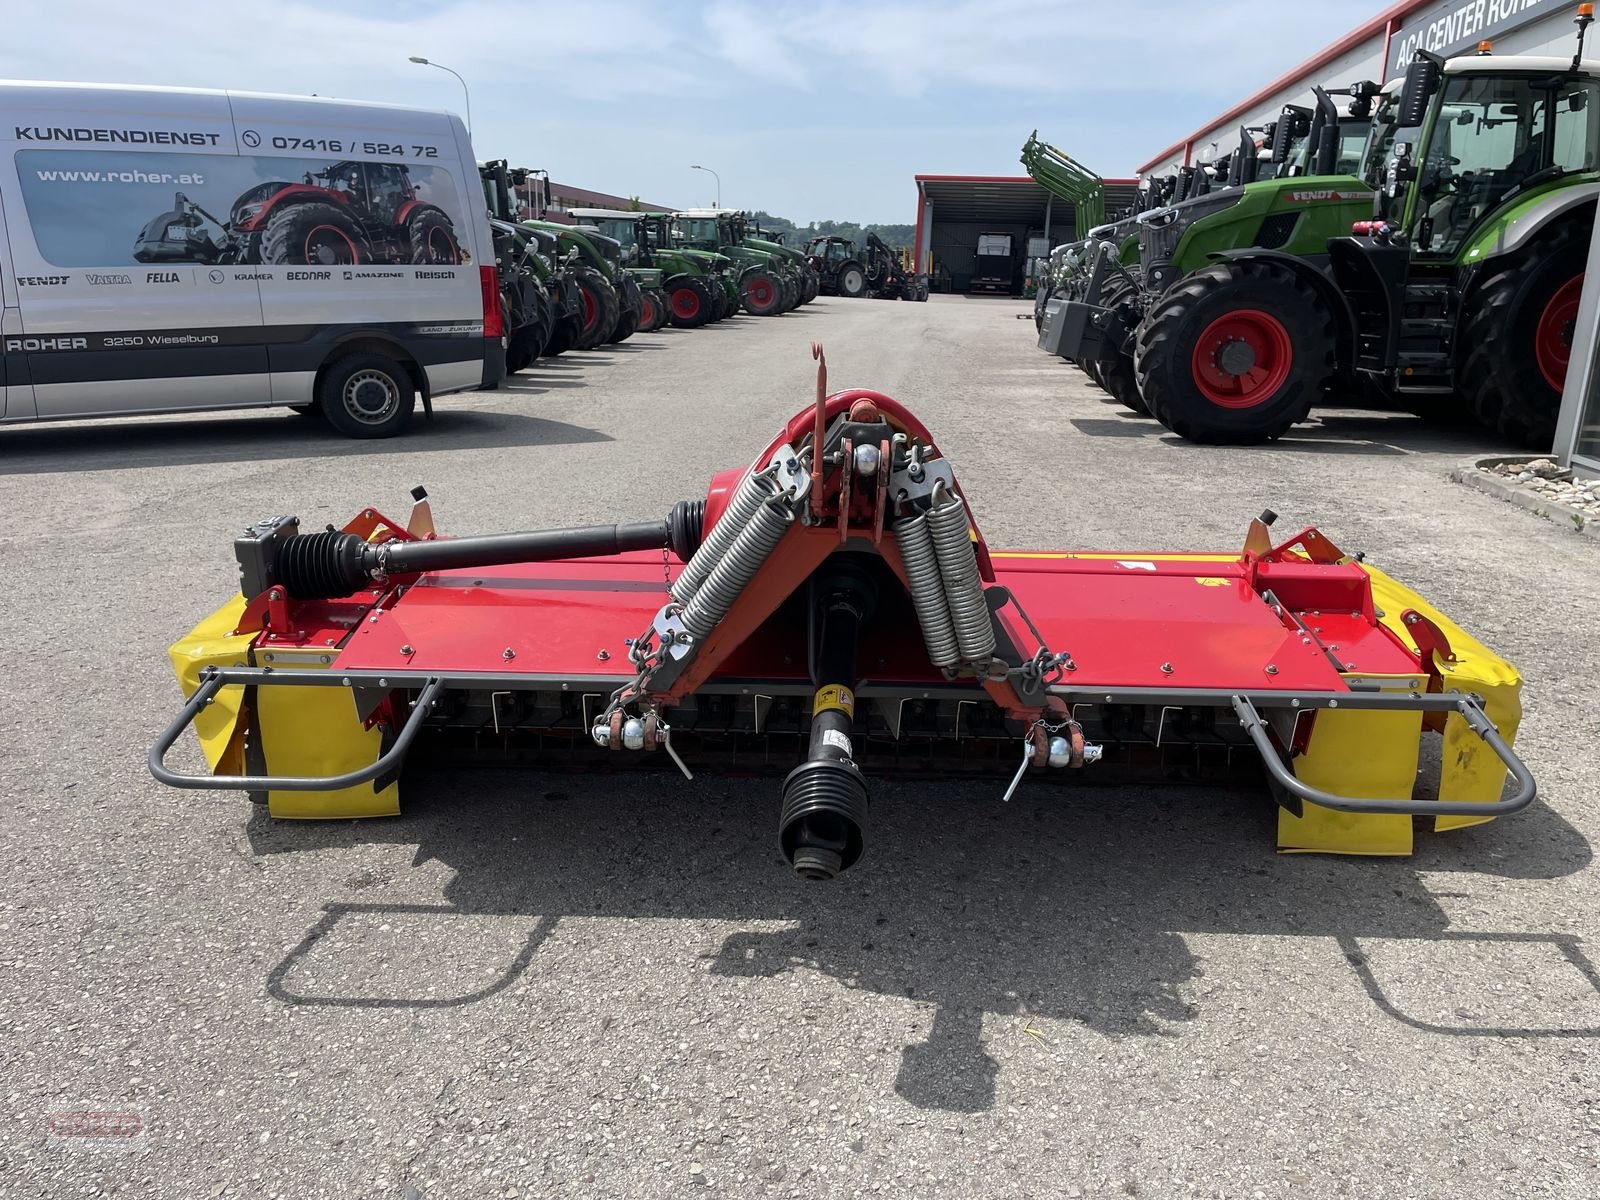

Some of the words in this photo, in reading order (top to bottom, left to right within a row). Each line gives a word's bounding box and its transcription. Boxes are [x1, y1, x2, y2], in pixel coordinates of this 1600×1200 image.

[1426, 0, 1486, 52] CENTER
[15, 127, 220, 146] KUNDENDIENST
[272, 136, 342, 153] 07416
[350, 141, 356, 153] /
[363, 142, 404, 156] 524
[412, 145, 438, 158] 72
[37, 169, 204, 185] www.roher.at
[1292, 190, 1335, 201] FENDT
[86, 274, 132, 285] VALTRA
[146, 272, 180, 283] FELLA
[234, 273, 274, 281] KRAMER
[286, 271, 331, 281] BEDNAR
[415, 270, 455, 280] Reisch
[17, 275, 70, 287] FENDT
[7, 337, 88, 352] ROHER
[103, 336, 144, 347] 3250
[147, 334, 219, 346] Wieselburg
